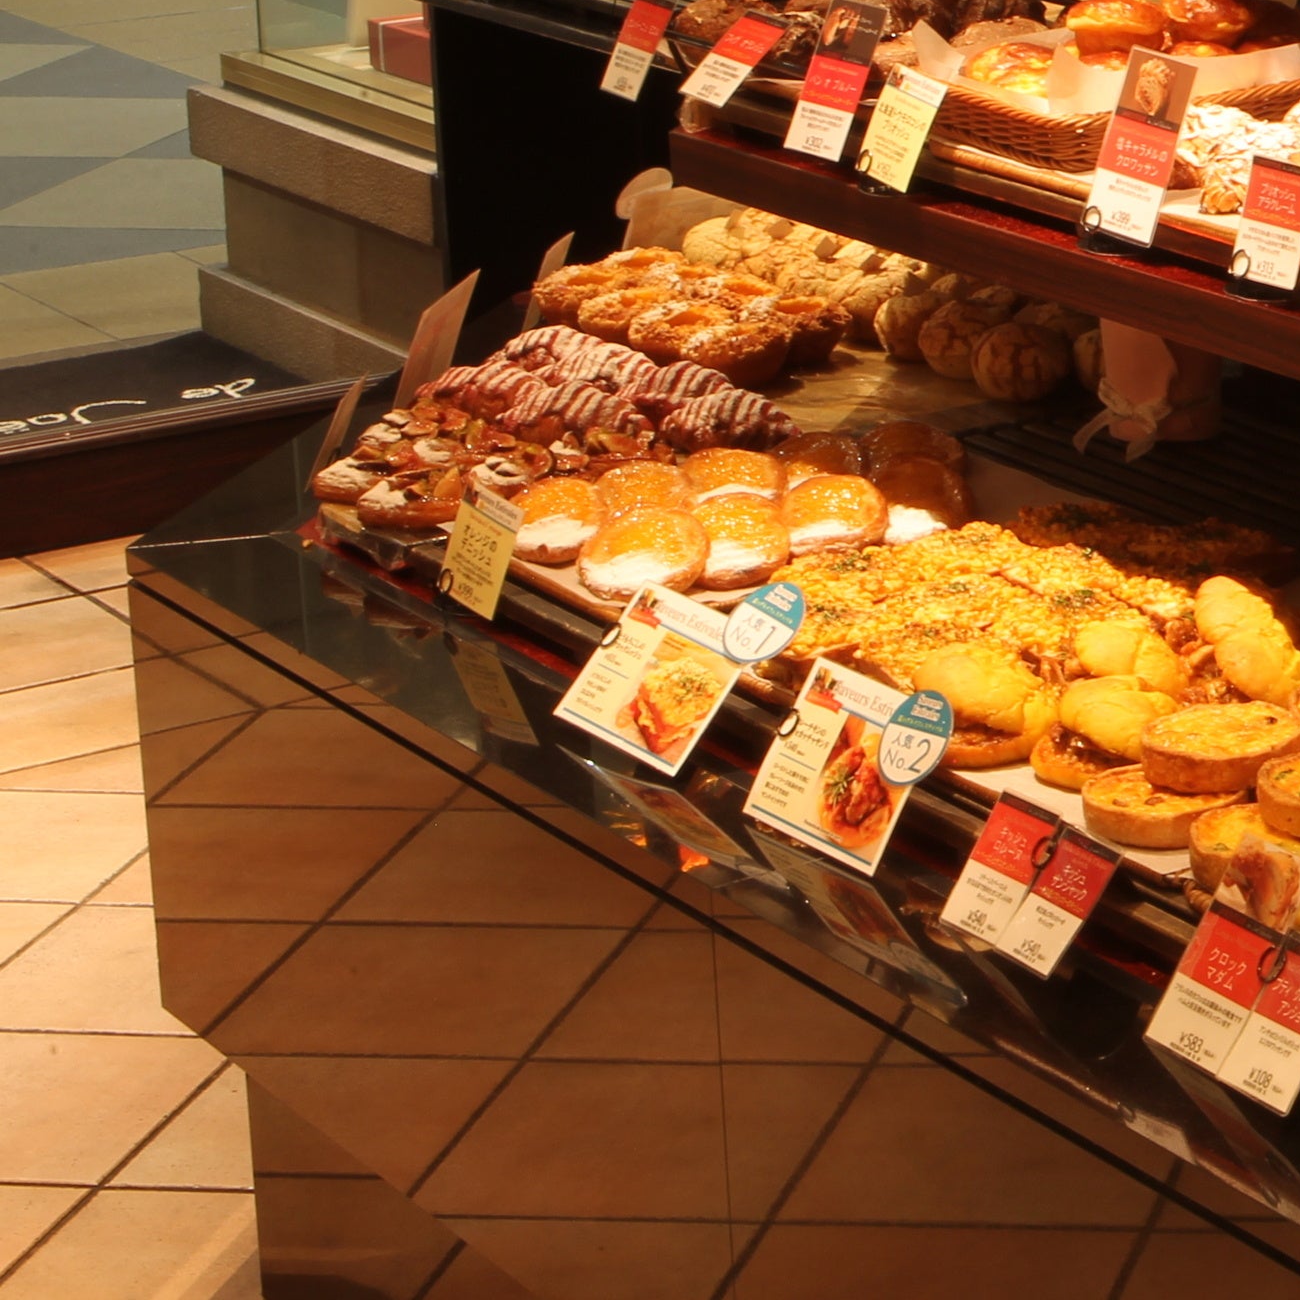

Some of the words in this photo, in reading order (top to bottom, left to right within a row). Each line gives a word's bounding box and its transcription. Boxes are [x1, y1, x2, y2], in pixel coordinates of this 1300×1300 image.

[1116, 154, 1159, 178] クロワッサン
[892, 732, 915, 750] 人気
[1208, 948, 1247, 975] クロック
[1207, 967, 1234, 991] マダム
[1179, 1032, 1204, 1053] ¥583
[1249, 1067, 1273, 1088] ¥108
